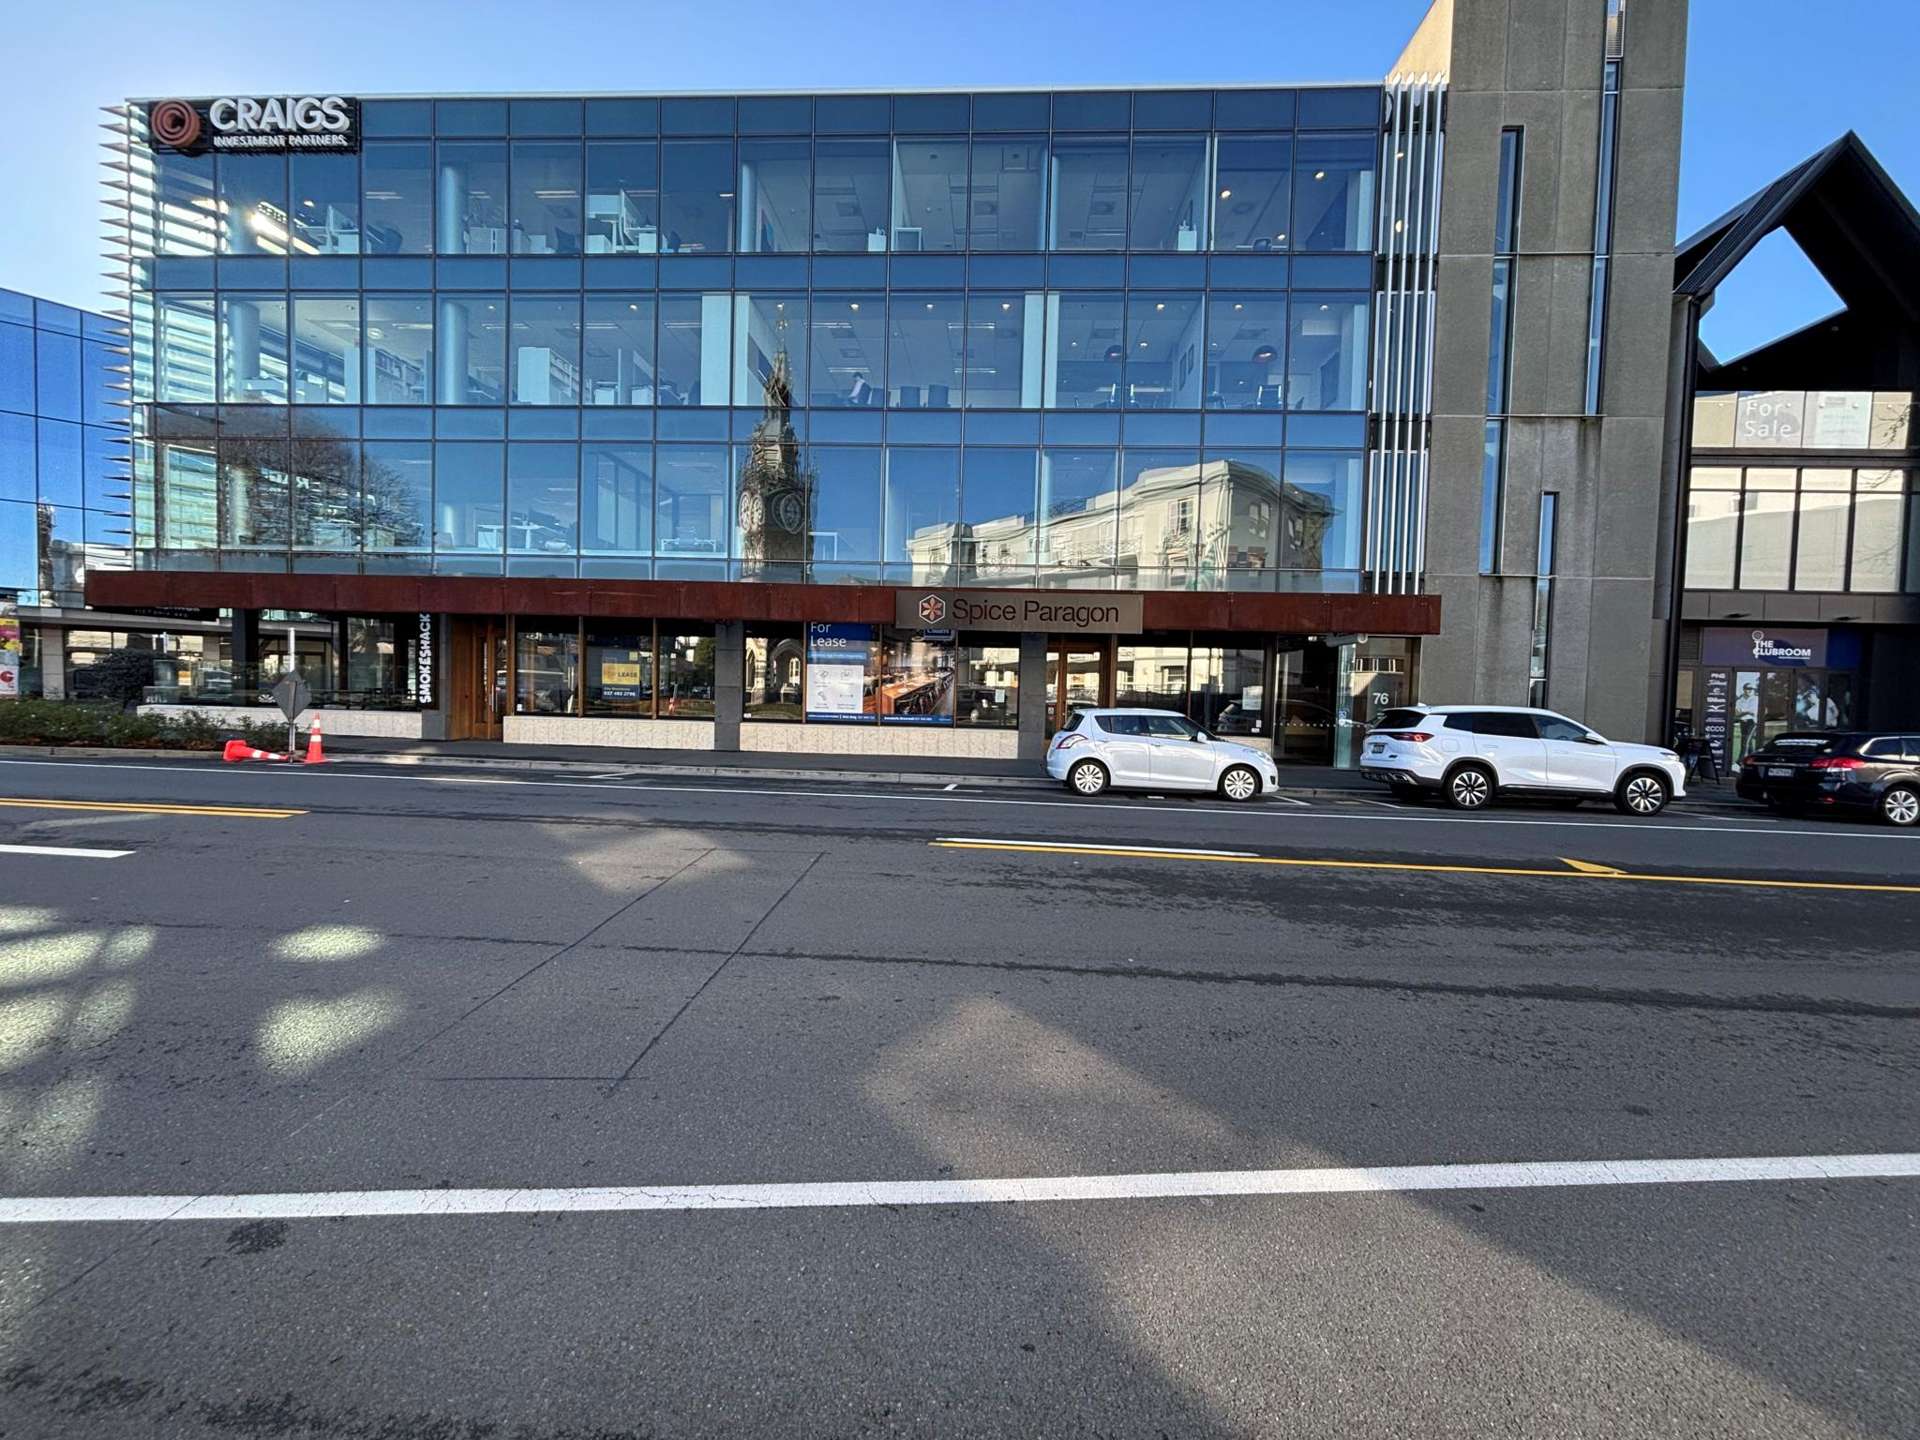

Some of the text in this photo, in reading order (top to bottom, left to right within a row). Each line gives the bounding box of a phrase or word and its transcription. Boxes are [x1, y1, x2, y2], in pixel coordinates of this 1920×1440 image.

[209, 96, 350, 132] CRAIGS
[213, 134, 349, 147] INVESTMENT PARTNERS
[1746, 400, 1785, 417] For
[1743, 420, 1792, 438] Sale
[952, 598, 1119, 628] Spice Paragon
[810, 622, 832, 633] For
[810, 635, 847, 647] Lease
[1754, 640, 1774, 648] THE
[418, 613, 432, 704] SMOKESHACK
[1752, 647, 1812, 657] CLUBROOM
[1372, 692, 1389, 705] 76
